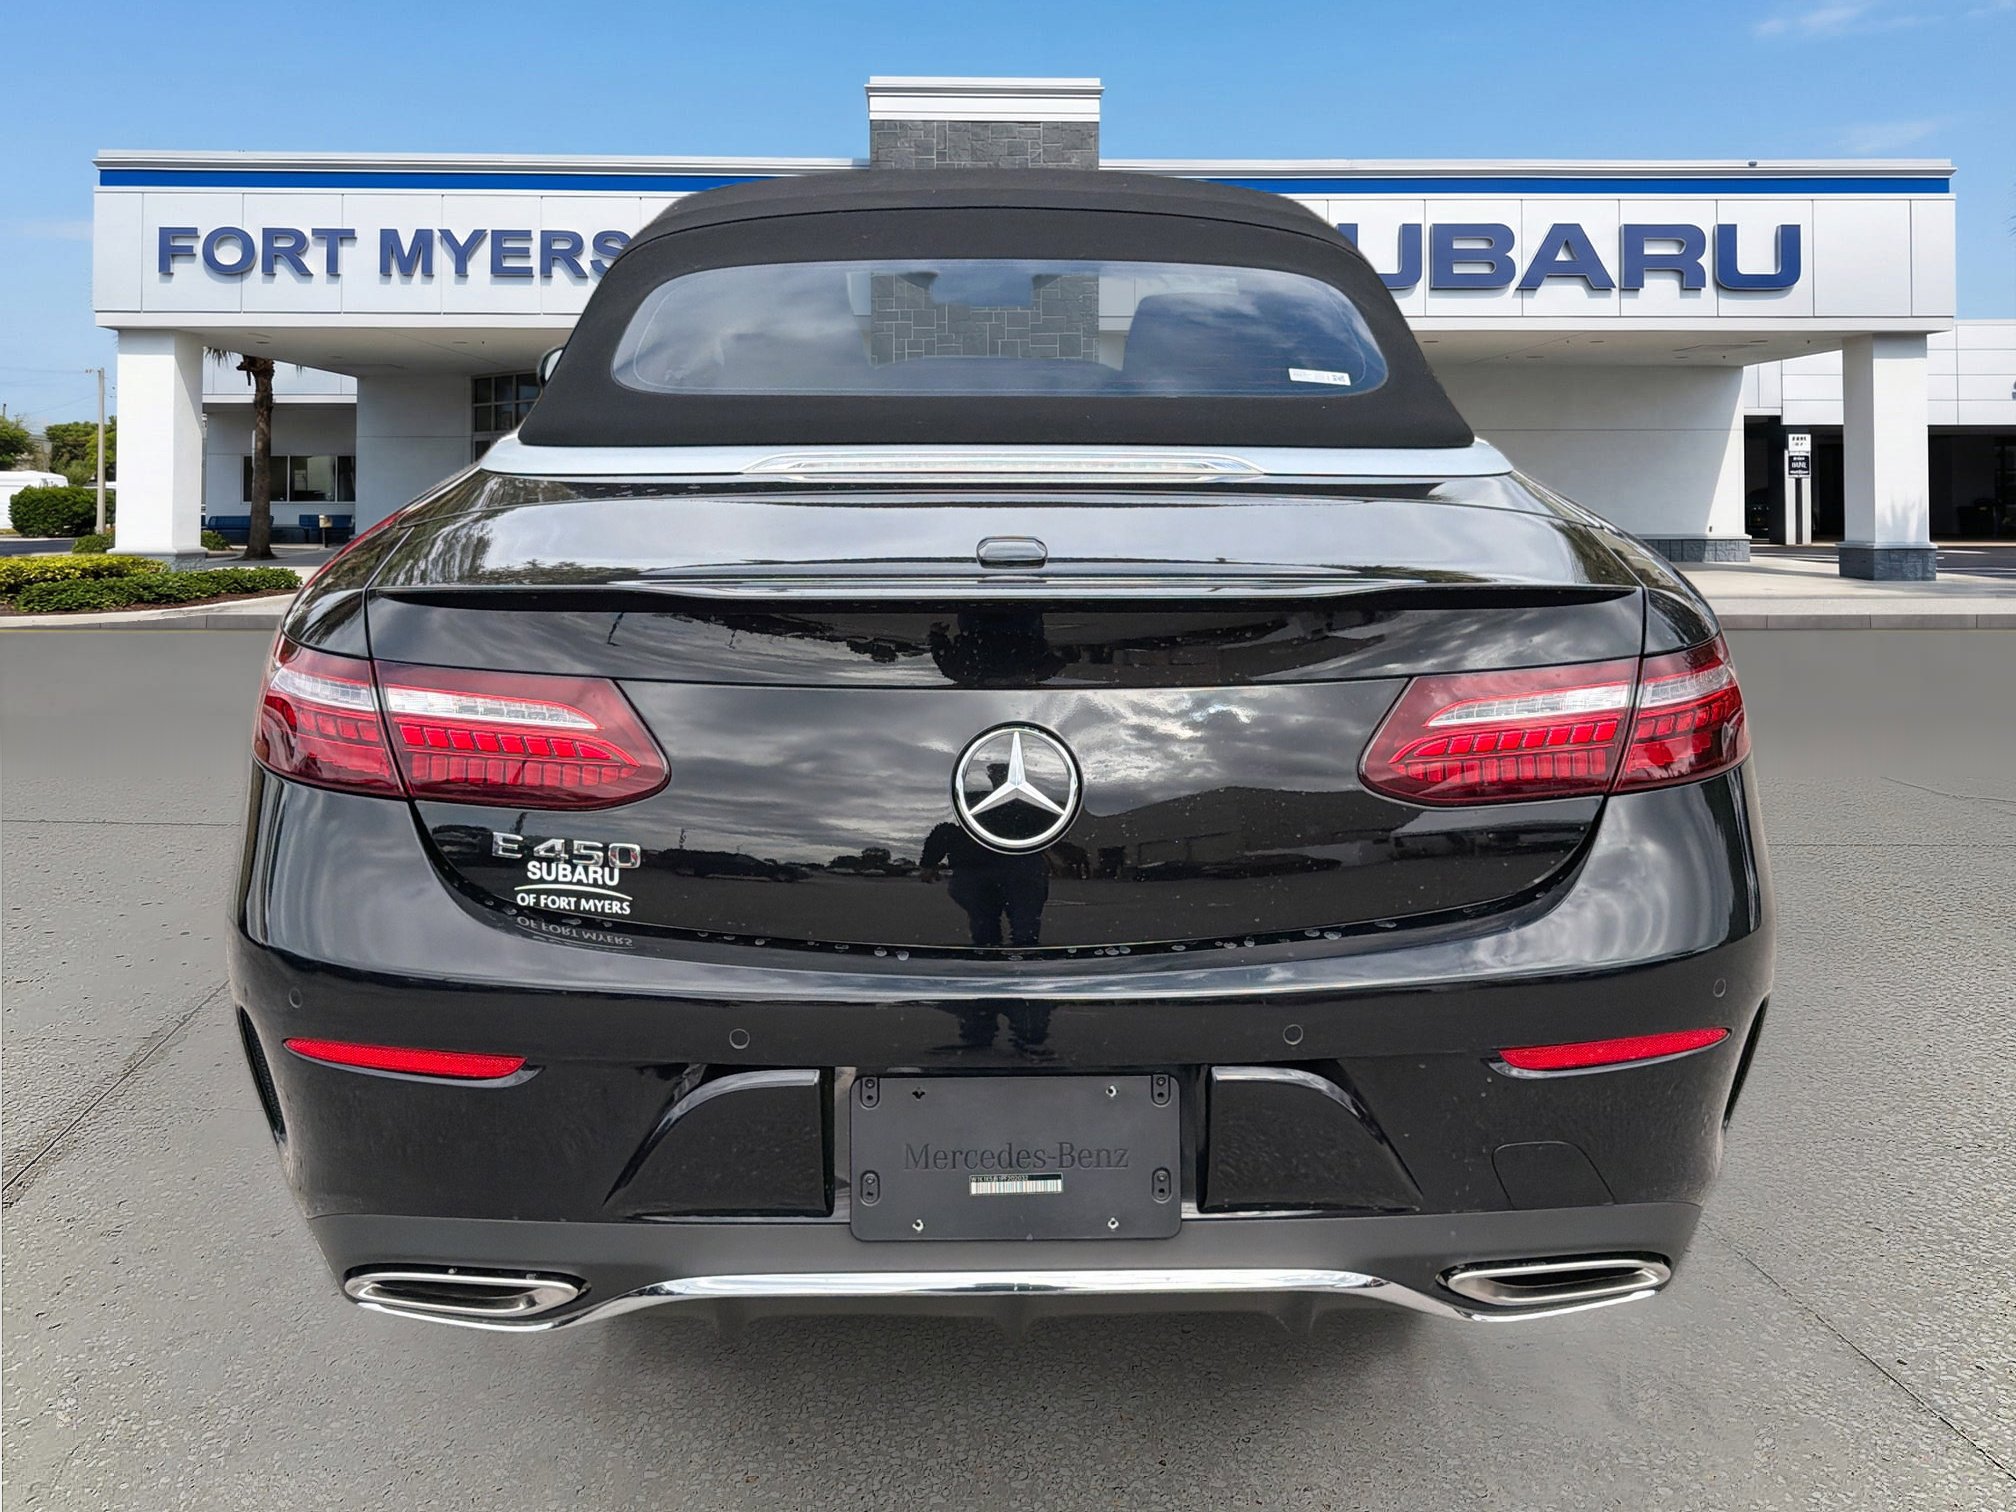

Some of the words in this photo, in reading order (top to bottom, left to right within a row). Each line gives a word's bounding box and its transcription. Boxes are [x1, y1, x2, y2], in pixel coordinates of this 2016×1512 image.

[158, 226, 357, 277] FORT
[379, 228, 631, 279] MYERS
[1335, 223, 1802, 291] UBARU
[492, 831, 523, 859] E
[533, 838, 641, 869] 450
[526, 860, 620, 886] SUBARU
[516, 893, 537, 907] OF
[540, 894, 577, 910] FORT
[580, 899, 631, 915] MYERS
[904, 1141, 1129, 1170] Mercedes-Benz
